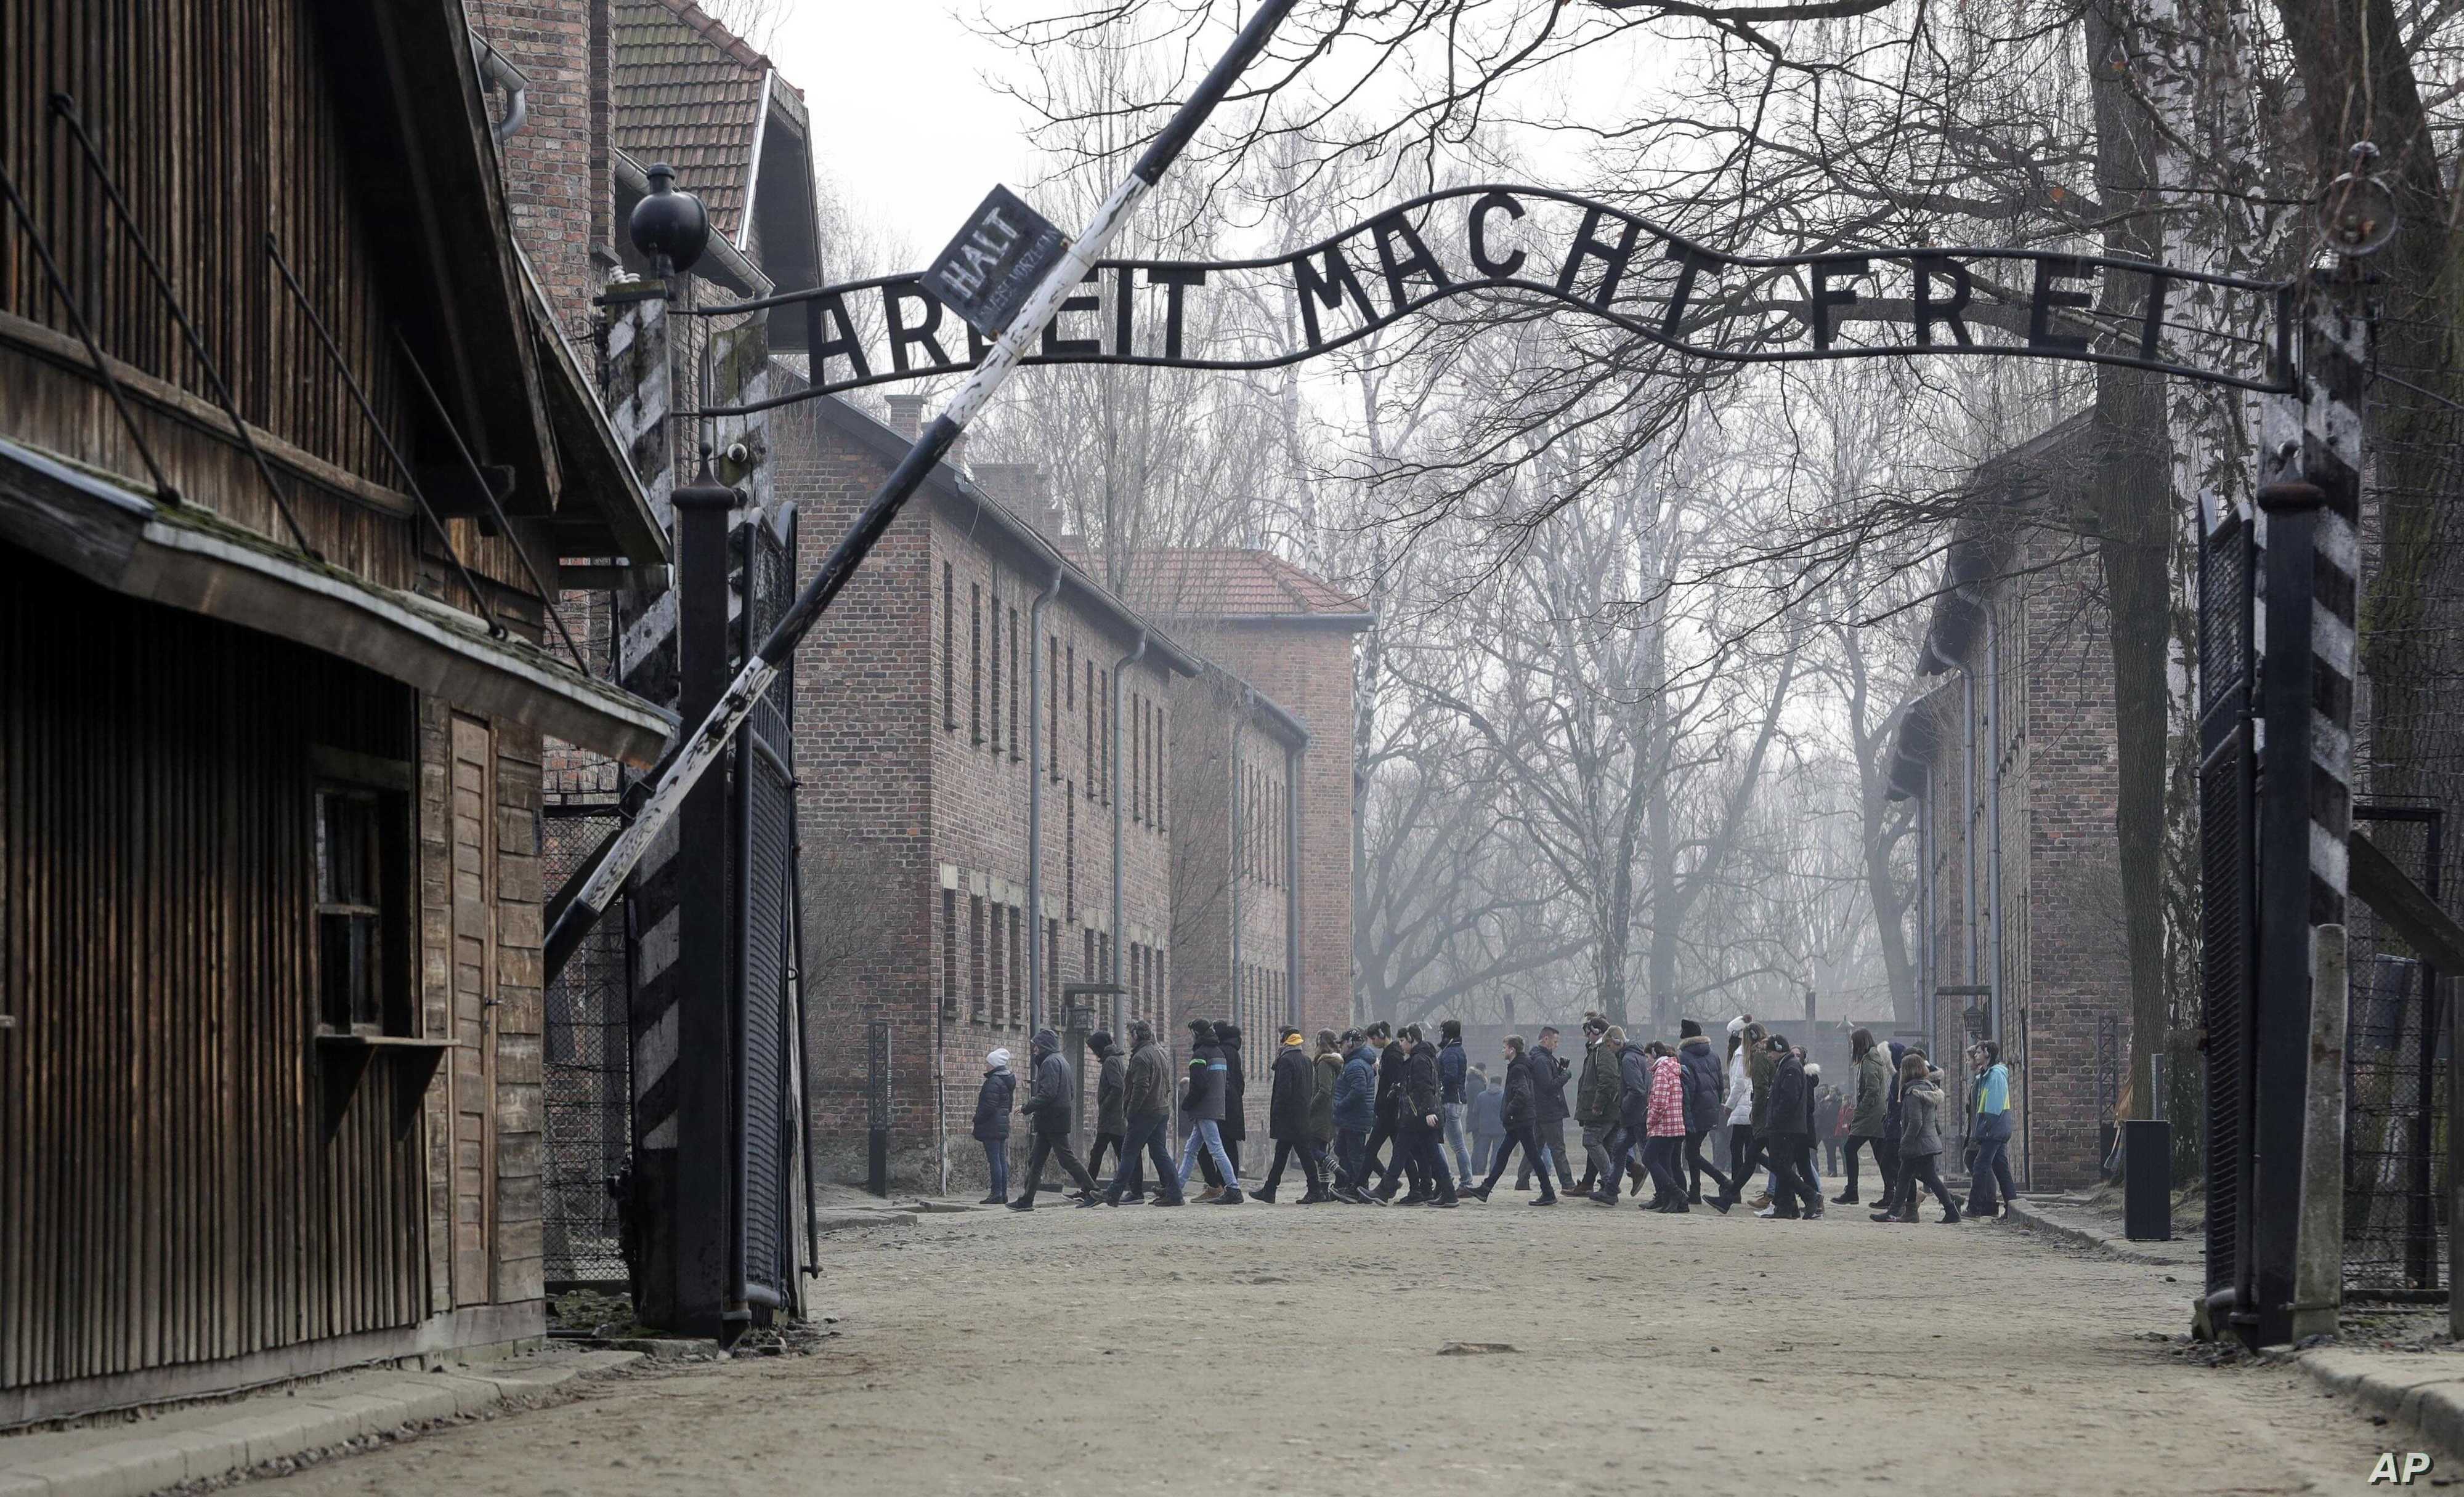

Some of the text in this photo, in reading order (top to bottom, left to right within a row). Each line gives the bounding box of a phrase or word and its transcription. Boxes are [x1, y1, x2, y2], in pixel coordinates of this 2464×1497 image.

[806, 192, 2168, 388] AREIT MACHT FREI
[939, 206, 1019, 299] HALT
